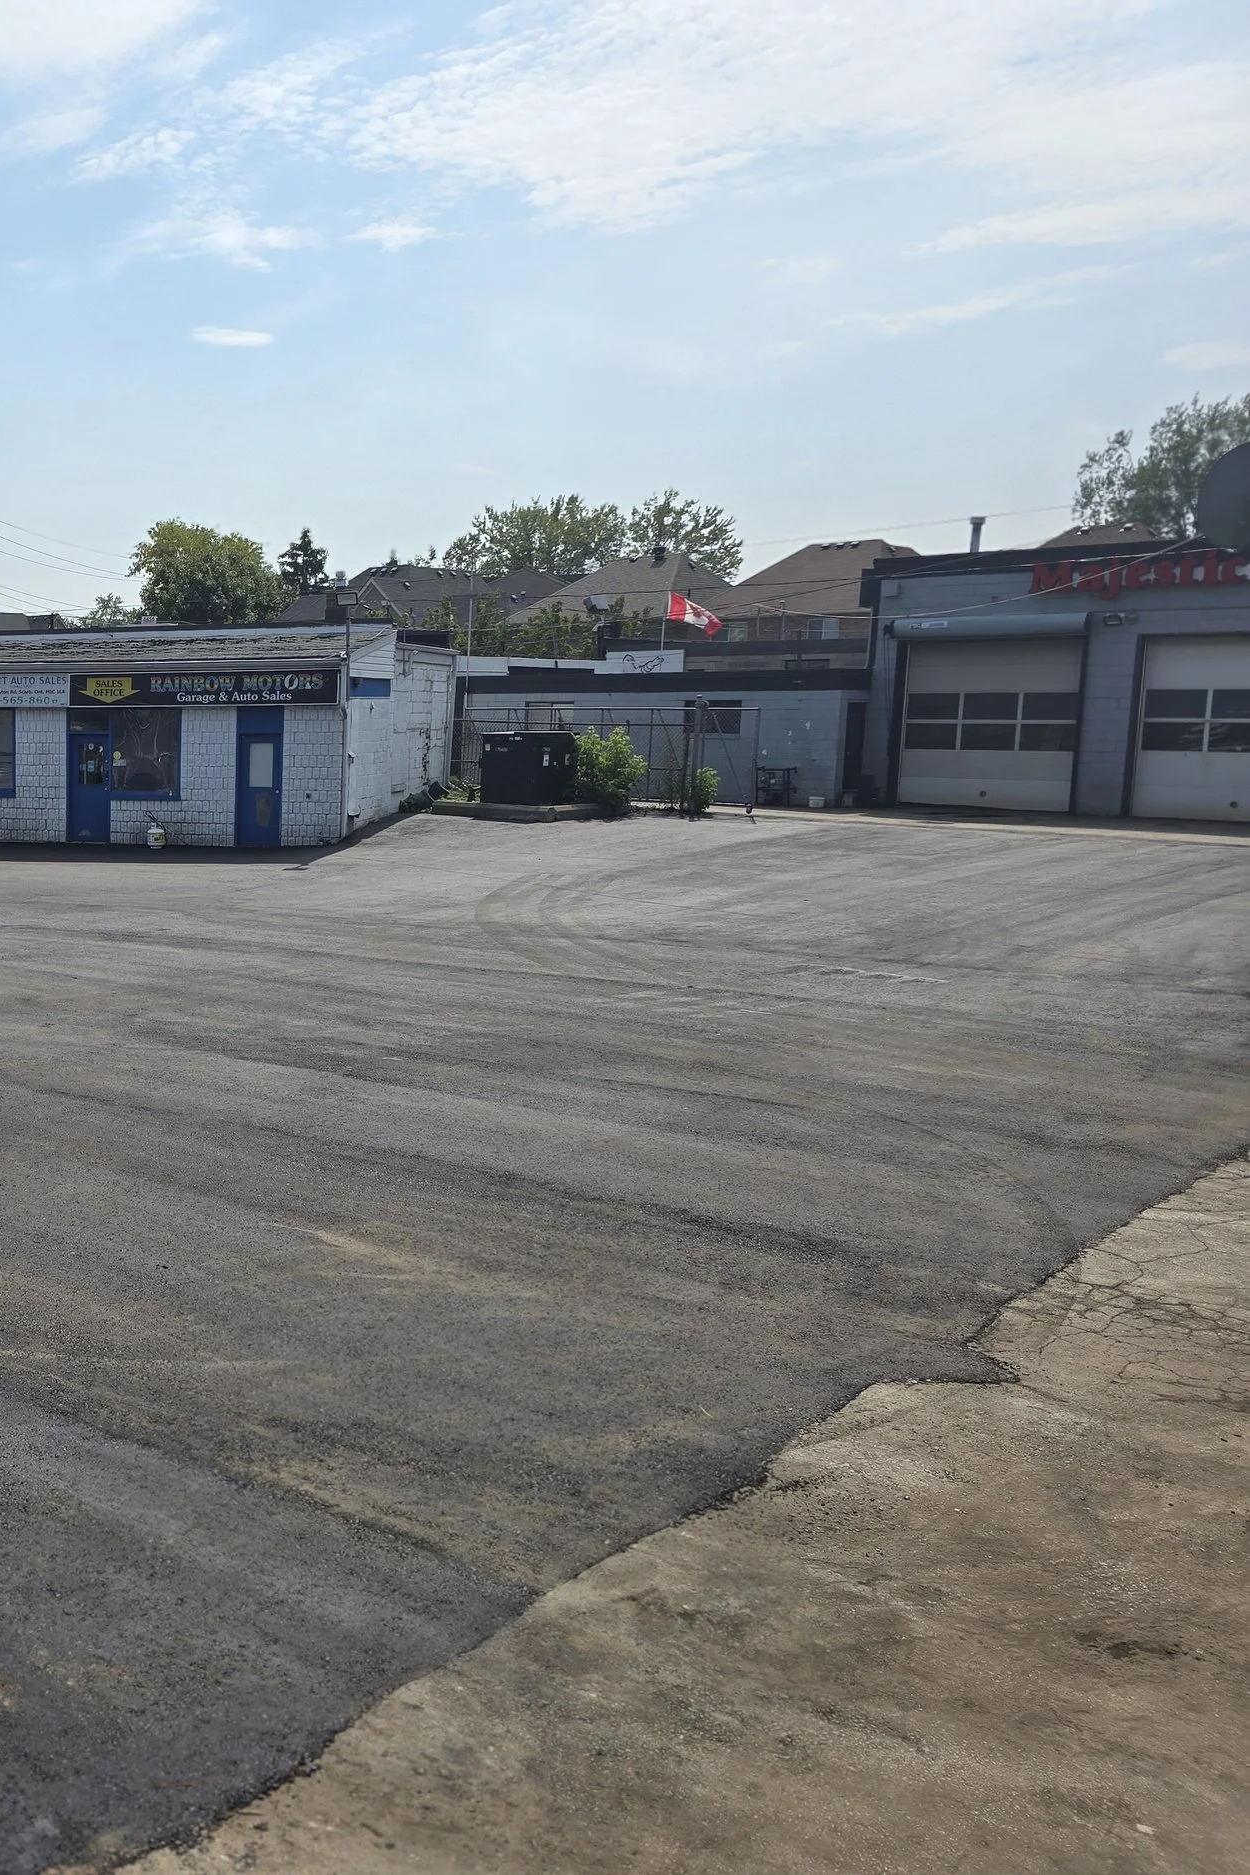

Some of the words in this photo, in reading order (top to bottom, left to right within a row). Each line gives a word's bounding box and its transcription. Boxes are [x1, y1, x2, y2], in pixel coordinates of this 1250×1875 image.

[1029, 550, 1250, 600] Majestic
[10, 676, 36, 685] AUTO
[39, 676, 67, 685] SALES
[95, 679, 123, 688] SALES
[150, 675, 236, 692] RAINBOW
[242, 673, 324, 690] MOTORS
[93, 688, 125, 697] OFFICE
[177, 692, 216, 703] Garage
[218, 691, 229, 701] &
[231, 692, 259, 701] Auto
[261, 690, 292, 701] Sales
